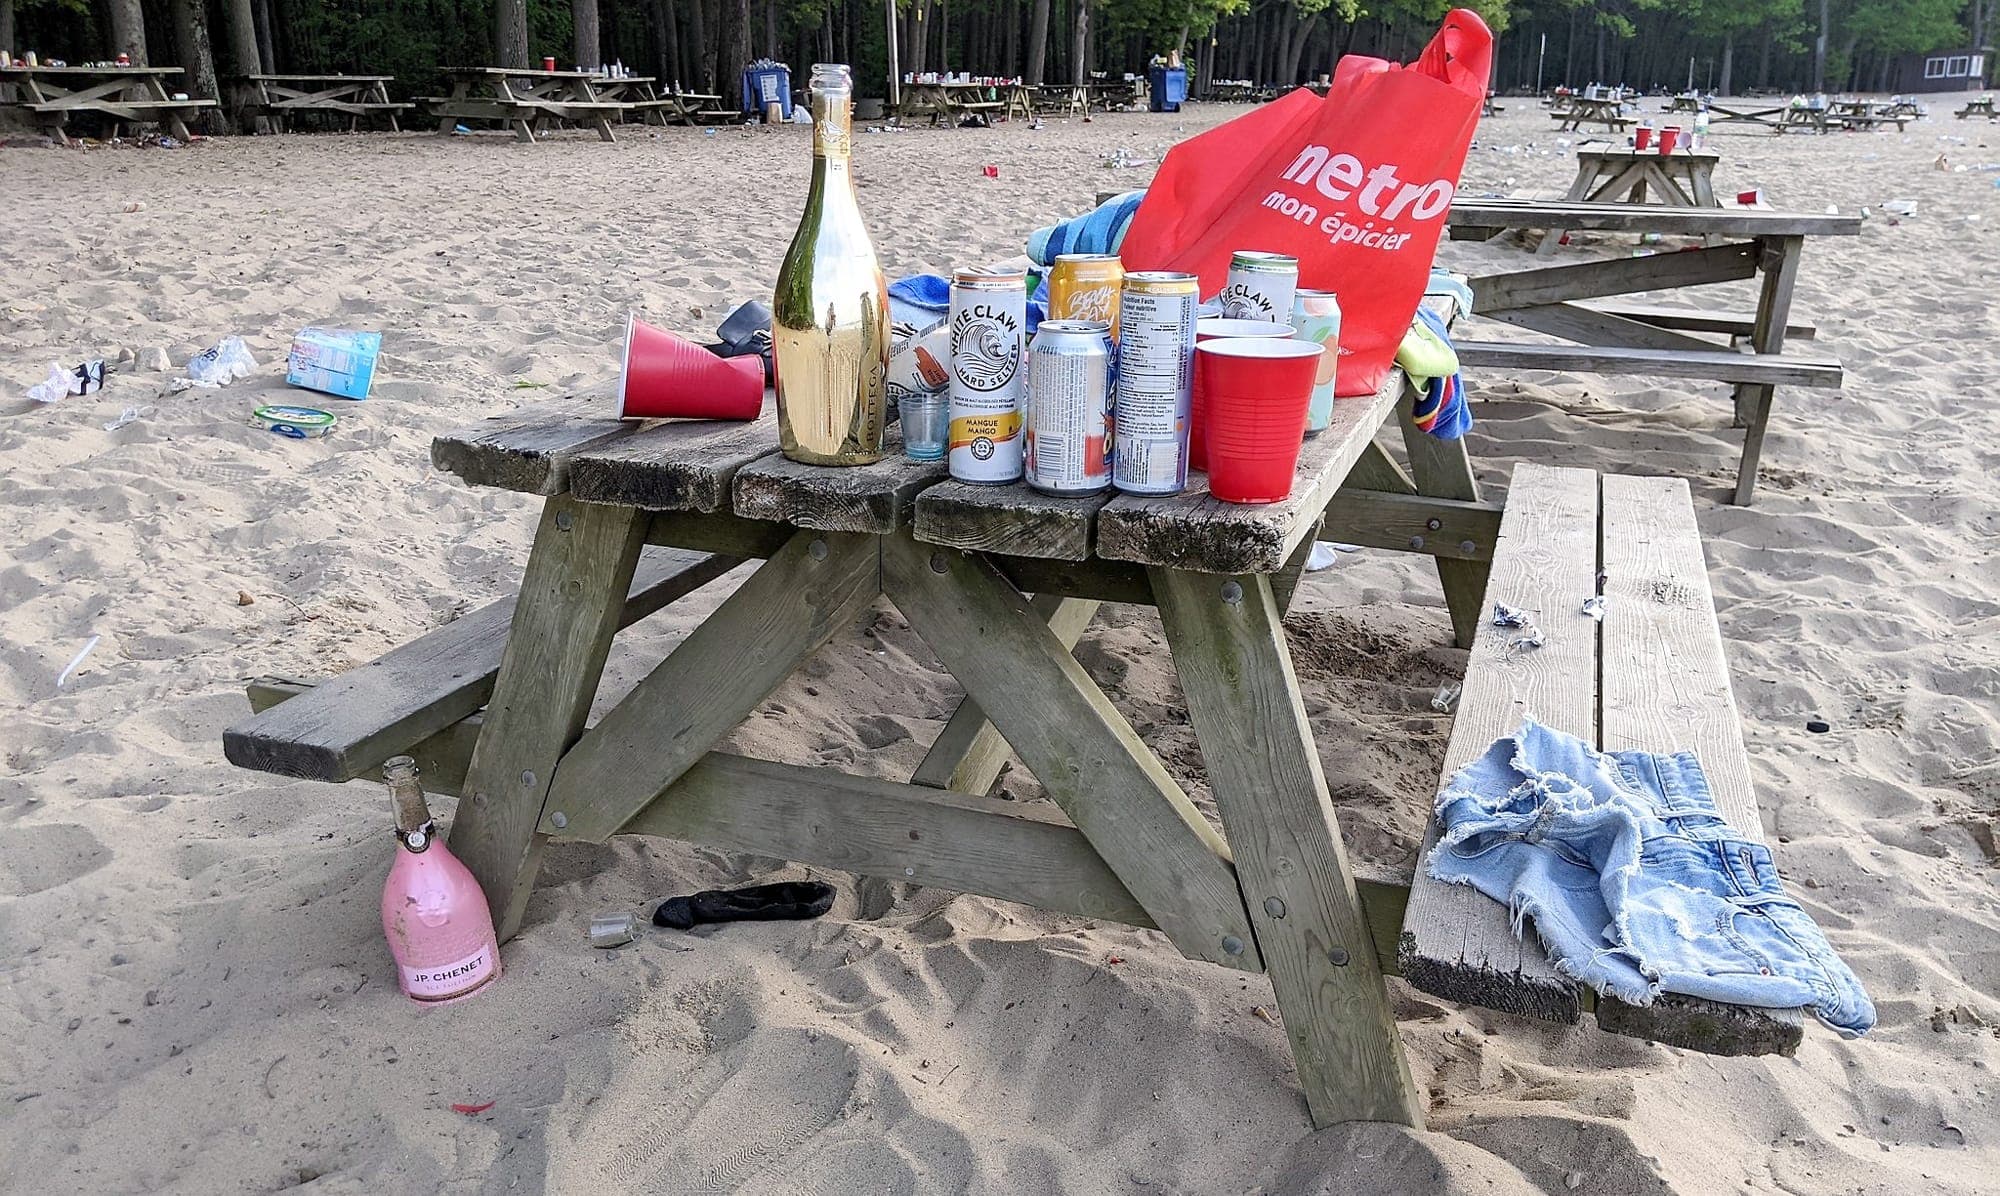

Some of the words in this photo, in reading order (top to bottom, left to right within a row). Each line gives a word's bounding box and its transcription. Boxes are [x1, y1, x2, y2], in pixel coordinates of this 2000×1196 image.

[1261, 190, 1318, 226] mon
[1320, 211, 1412, 250] épicier
[1234, 283, 1273, 312] CLAW
[951, 308, 972, 357] WHITE
[974, 304, 1018, 333] CLAW
[959, 367, 985, 387] HARD
[990, 344, 1017, 386] SELTZER
[866, 366, 879, 442] BOTTEGA
[966, 419, 999, 427] MANGUE
[967, 427, 996, 435] MANGO
[433, 956, 483, 982] CHENET
